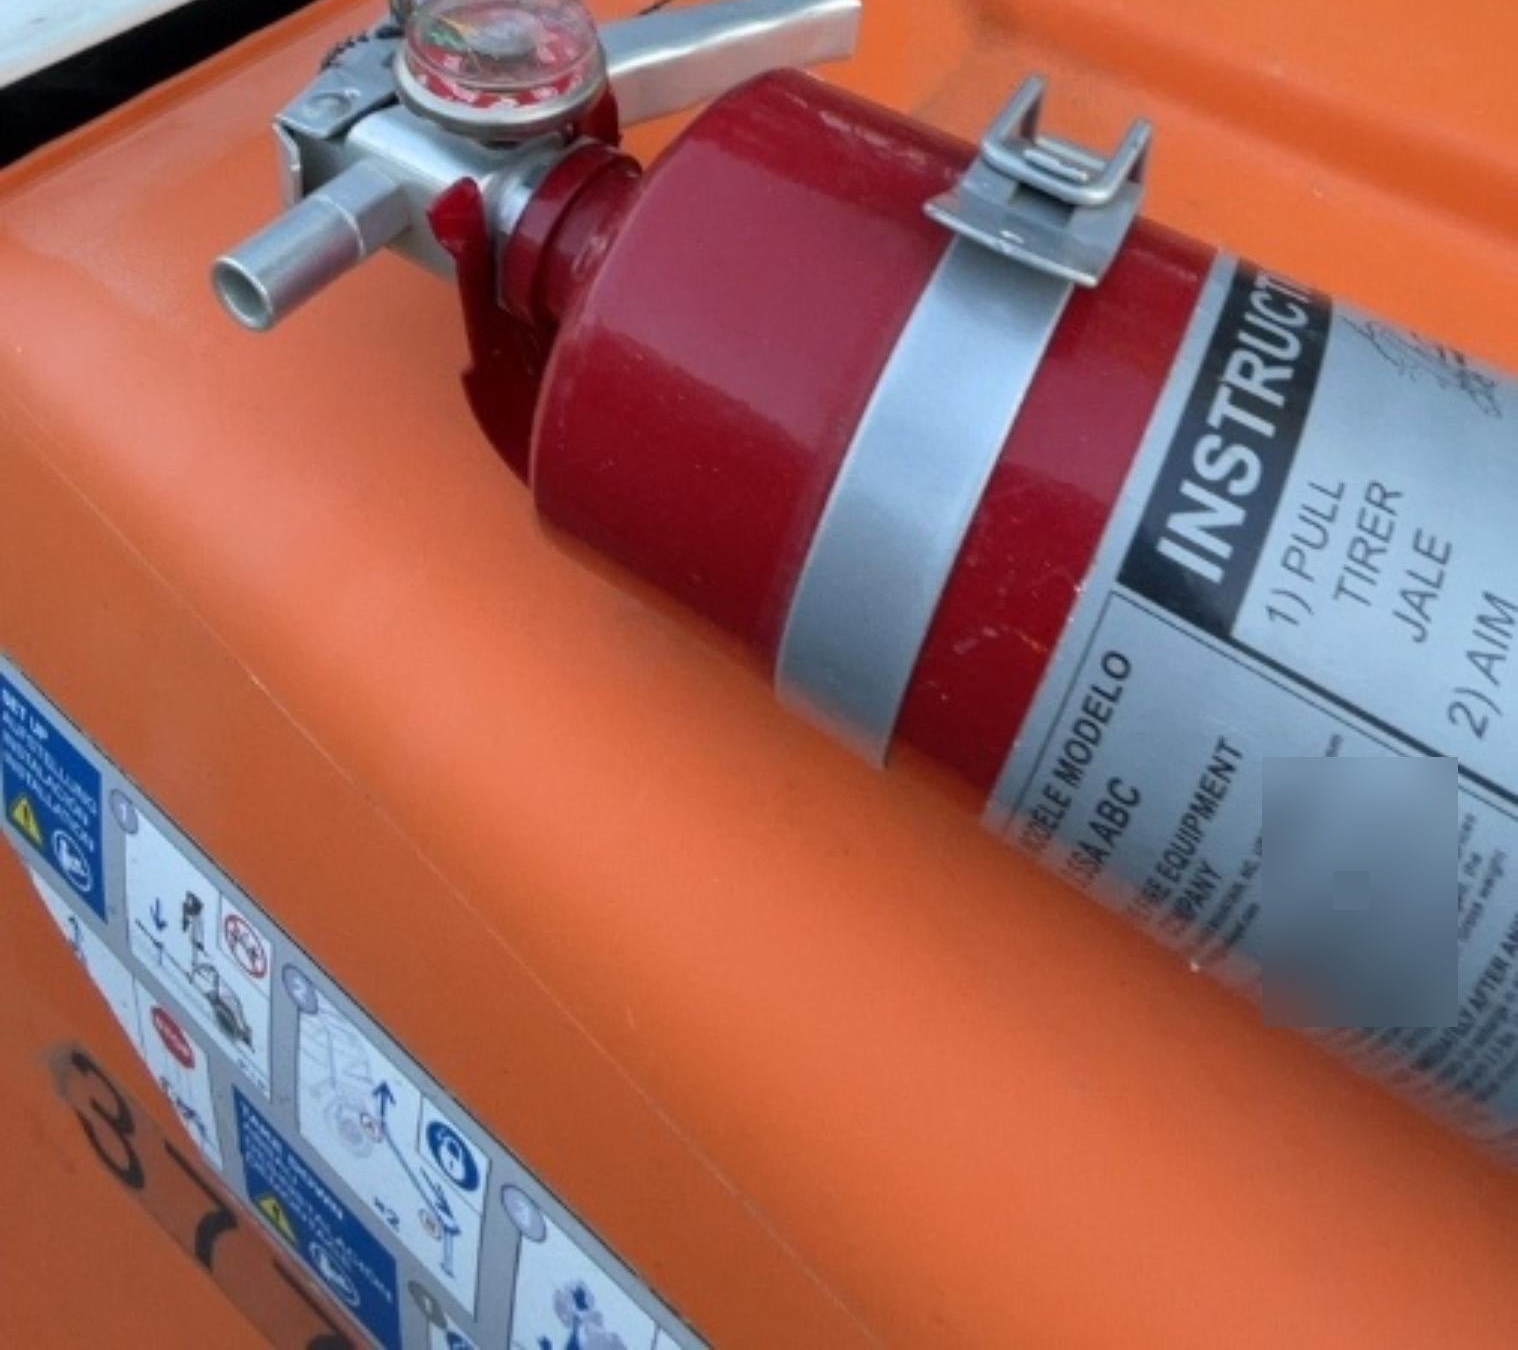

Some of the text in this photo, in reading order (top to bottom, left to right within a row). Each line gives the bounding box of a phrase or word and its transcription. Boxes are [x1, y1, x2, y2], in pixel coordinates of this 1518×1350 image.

[1265, 481, 1346, 627] 1) PULL
[1333, 480, 1403, 607] TIRER
[1392, 527, 1453, 643] JALE
[1056, 650, 1132, 789] MODELO
[1447, 590, 1518, 740] 2) AIM
[1088, 776, 1141, 850] ABC
[1155, 736, 1243, 883] EQUIPMENT
